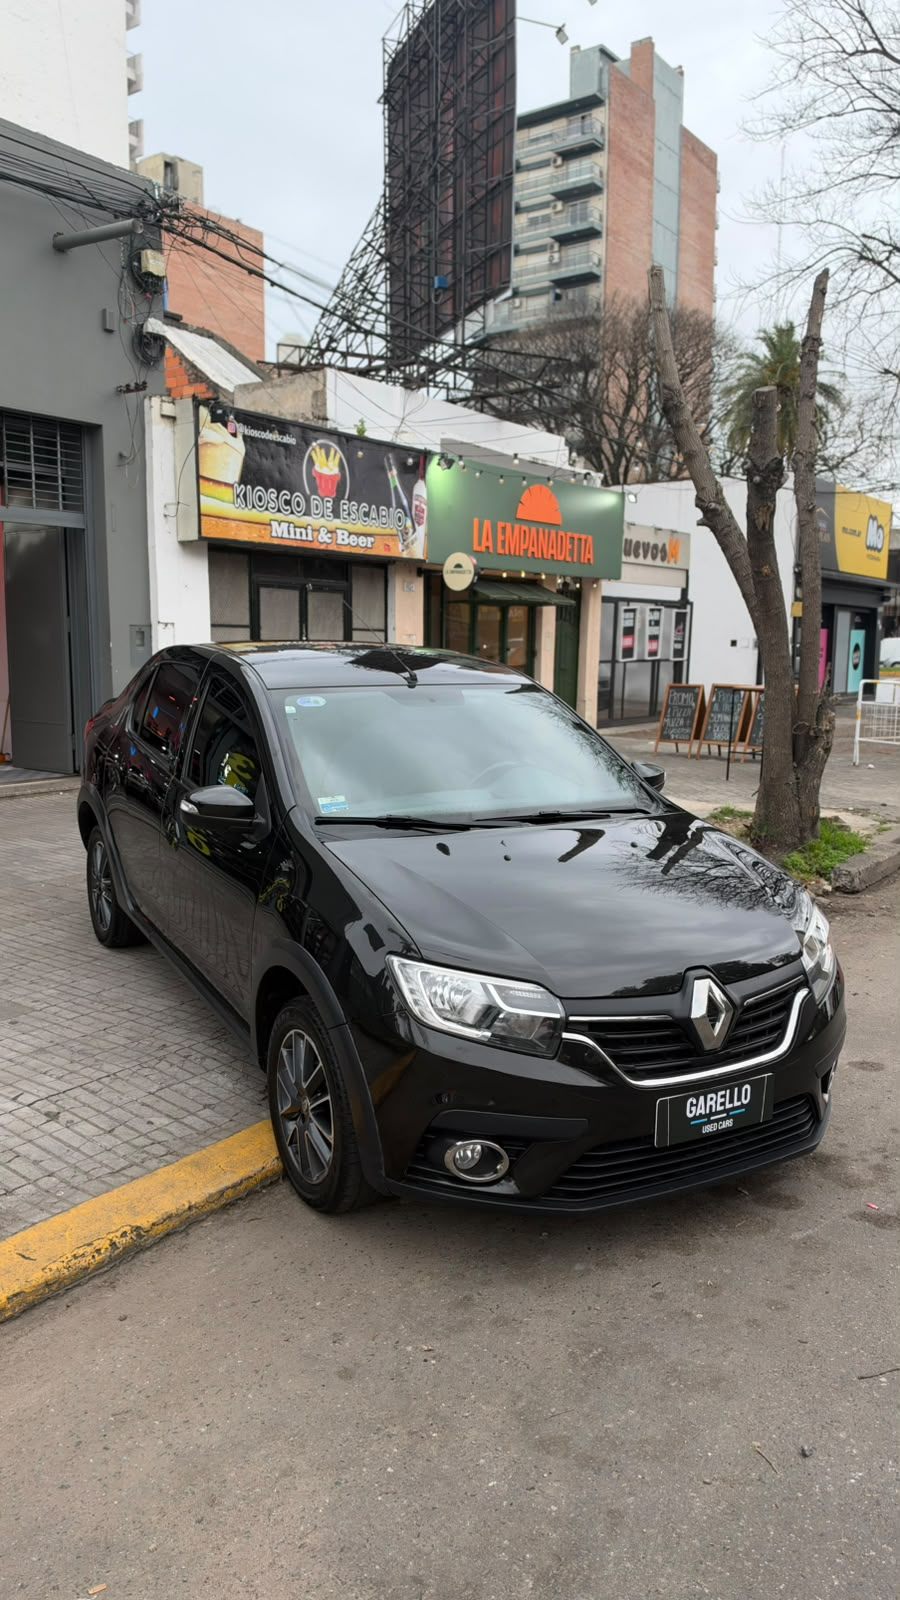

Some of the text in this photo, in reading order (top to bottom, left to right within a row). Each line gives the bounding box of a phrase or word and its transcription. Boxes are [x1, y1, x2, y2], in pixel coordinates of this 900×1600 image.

[233, 483, 306, 517] KIOSCO
[310, 495, 334, 520] DE
[340, 500, 406, 529] ESCABIO
[270, 520, 375, 549] Mini & Beer
[473, 517, 594, 566] LA EMPANADETTA
[623, 537, 668, 563] uevos
[686, 1084, 751, 1118] GARELLO
[702, 1119, 734, 1133] USED CARS
